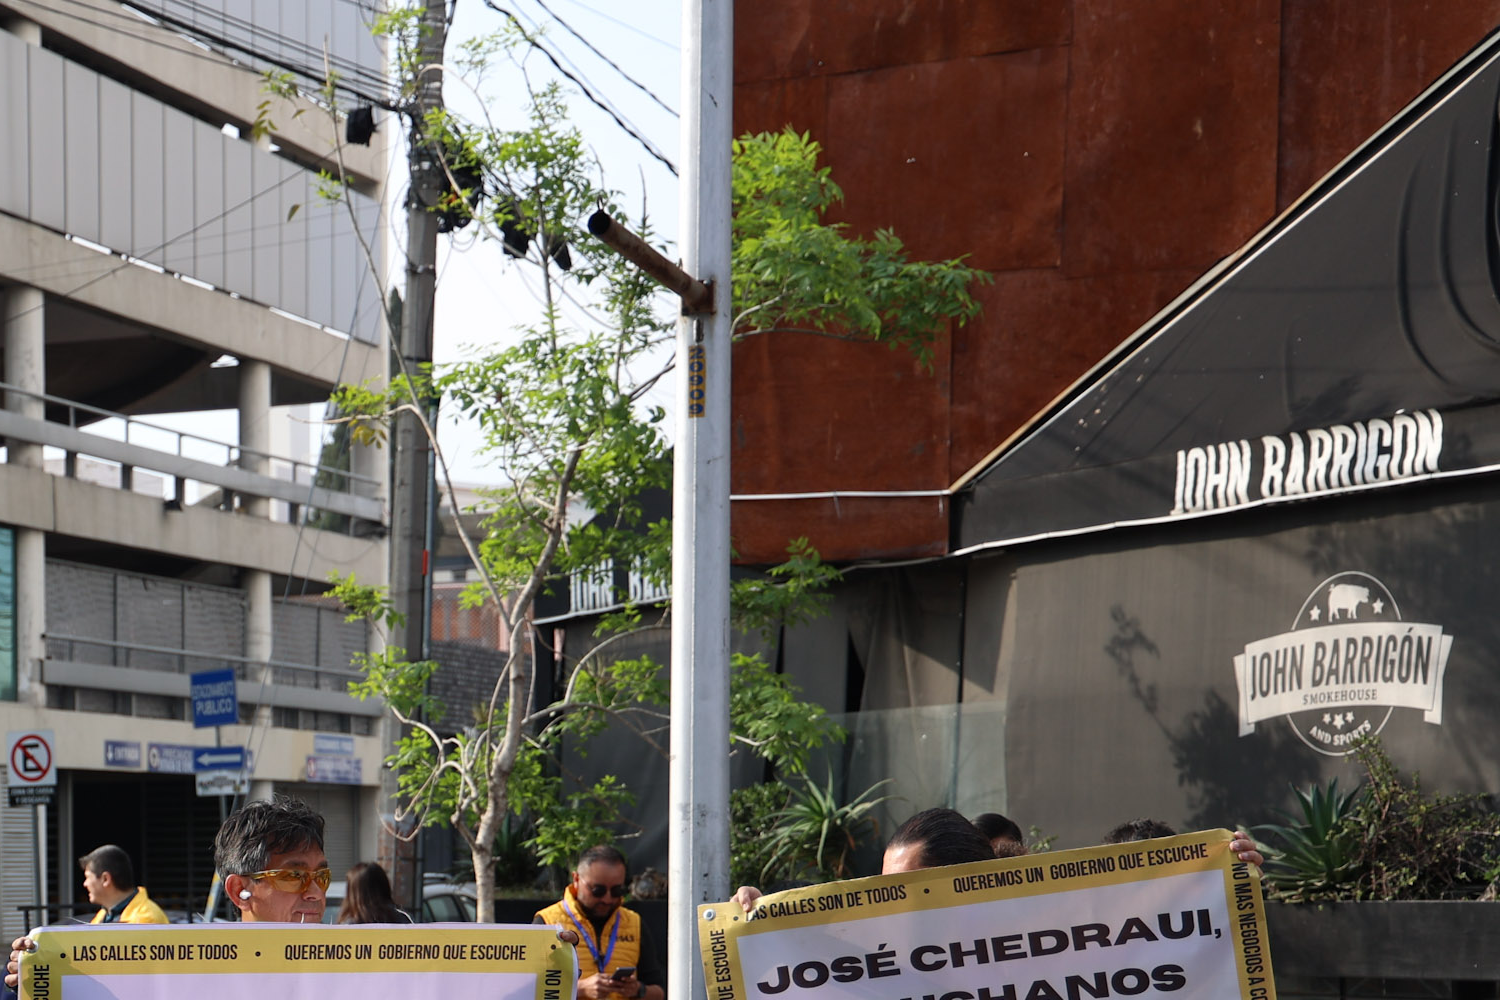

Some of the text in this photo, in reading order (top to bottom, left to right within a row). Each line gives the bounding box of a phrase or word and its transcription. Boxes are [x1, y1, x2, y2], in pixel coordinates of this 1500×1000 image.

[688, 346, 705, 416] 20909
[1170, 408, 1444, 516] JOHN BARRIGÓN
[1250, 626, 1433, 702] JOHN BARRIGÓN
[1302, 688, 1378, 706] SMOKEHOUSE
[1308, 719, 1372, 746] AND SPORTS
[952, 843, 1208, 893] QUEREMOS UN GOBIERNO QUE ESCUCHE
[1230, 858, 1251, 880] NO
[768, 897, 816, 918] CALLES
[817, 893, 844, 912] SON
[845, 890, 864, 908] DE
[863, 883, 907, 905] TODOS
[1233, 881, 1254, 911] MAS
[72, 943, 238, 961] LAS CALLES SON DE TODOS
[284, 943, 527, 961] QUEREMOS UN GOBIERNO QUE ESCUCHE
[756, 908, 1222, 995] JOSÉ CHEDRAUI,
[1237, 911, 1264, 974] NEGOCIOS
[544, 969, 562, 986] NO
[1247, 976, 1265, 986] A
